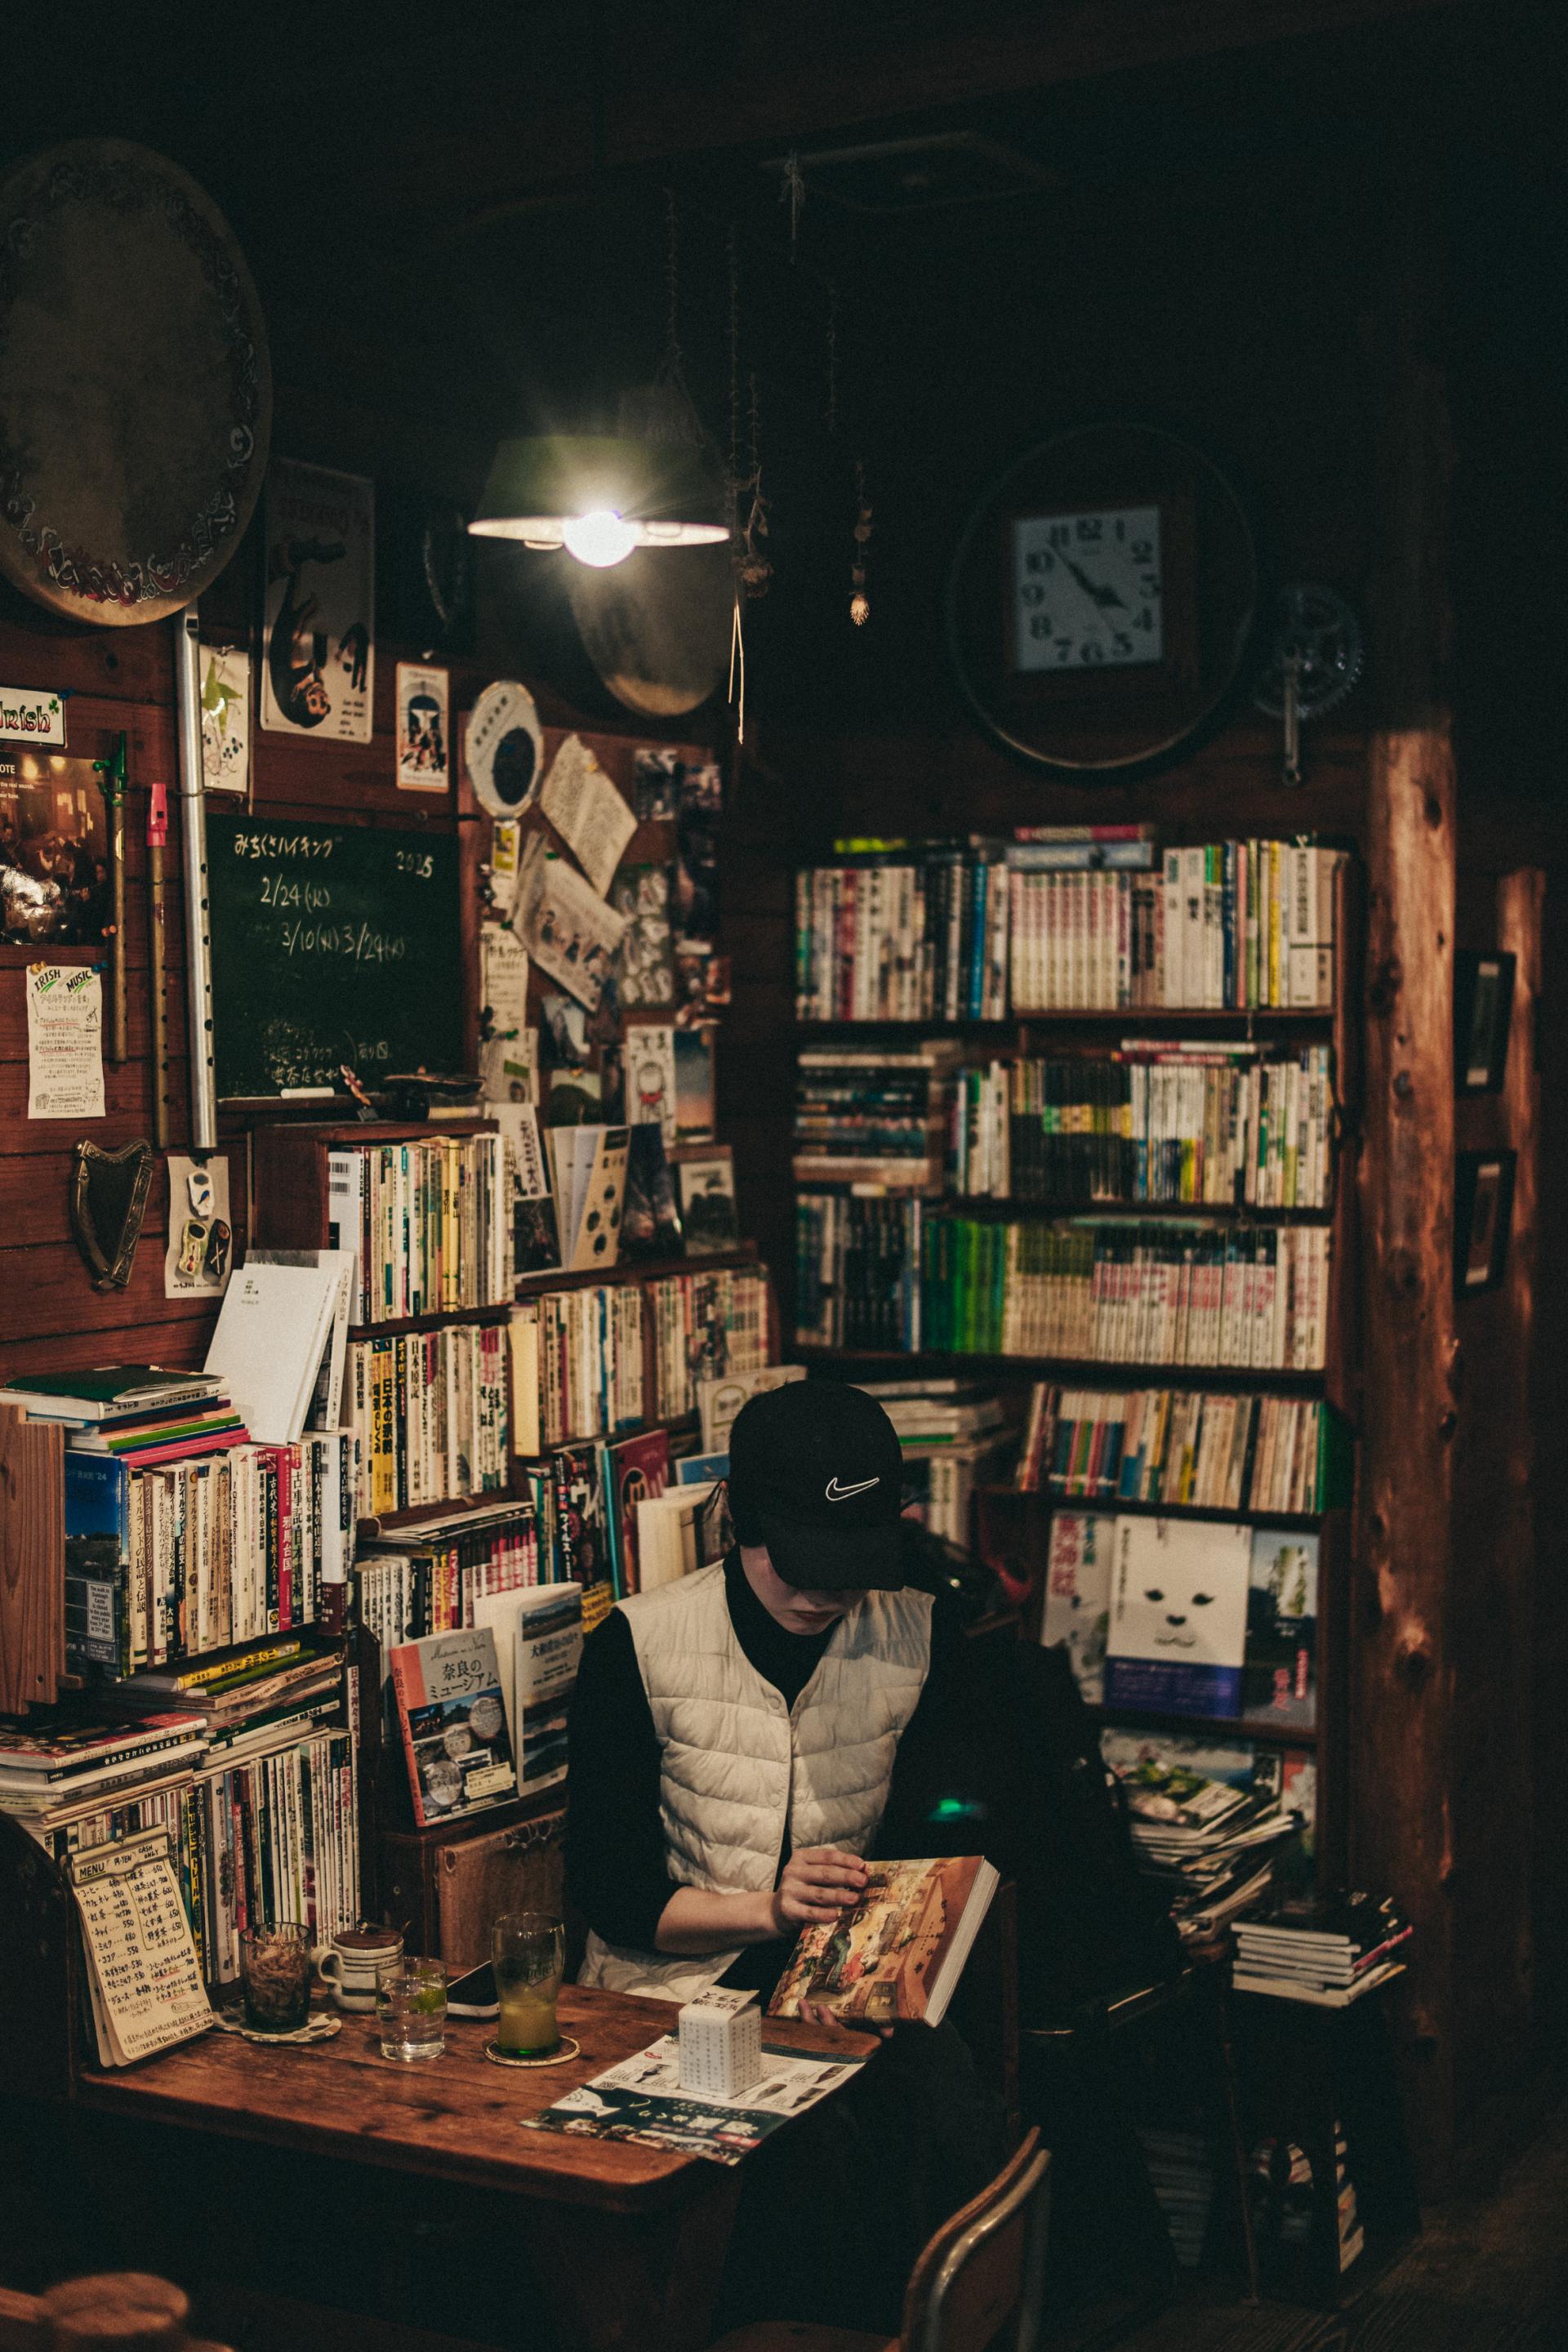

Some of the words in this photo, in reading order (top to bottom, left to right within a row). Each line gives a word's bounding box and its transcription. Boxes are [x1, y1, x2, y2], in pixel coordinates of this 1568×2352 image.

[234, 834, 342, 858] みちくさハイキング
[34, 969, 61, 991] IRISH
[66, 970, 92, 992] MUSIC
[136, 1484, 147, 1614] アイルランドの民話と伝説
[443, 1659, 482, 1681] 奈良の
[430, 1672, 498, 1699] ミュージアム
[79, 1863, 105, 1878] MENU
